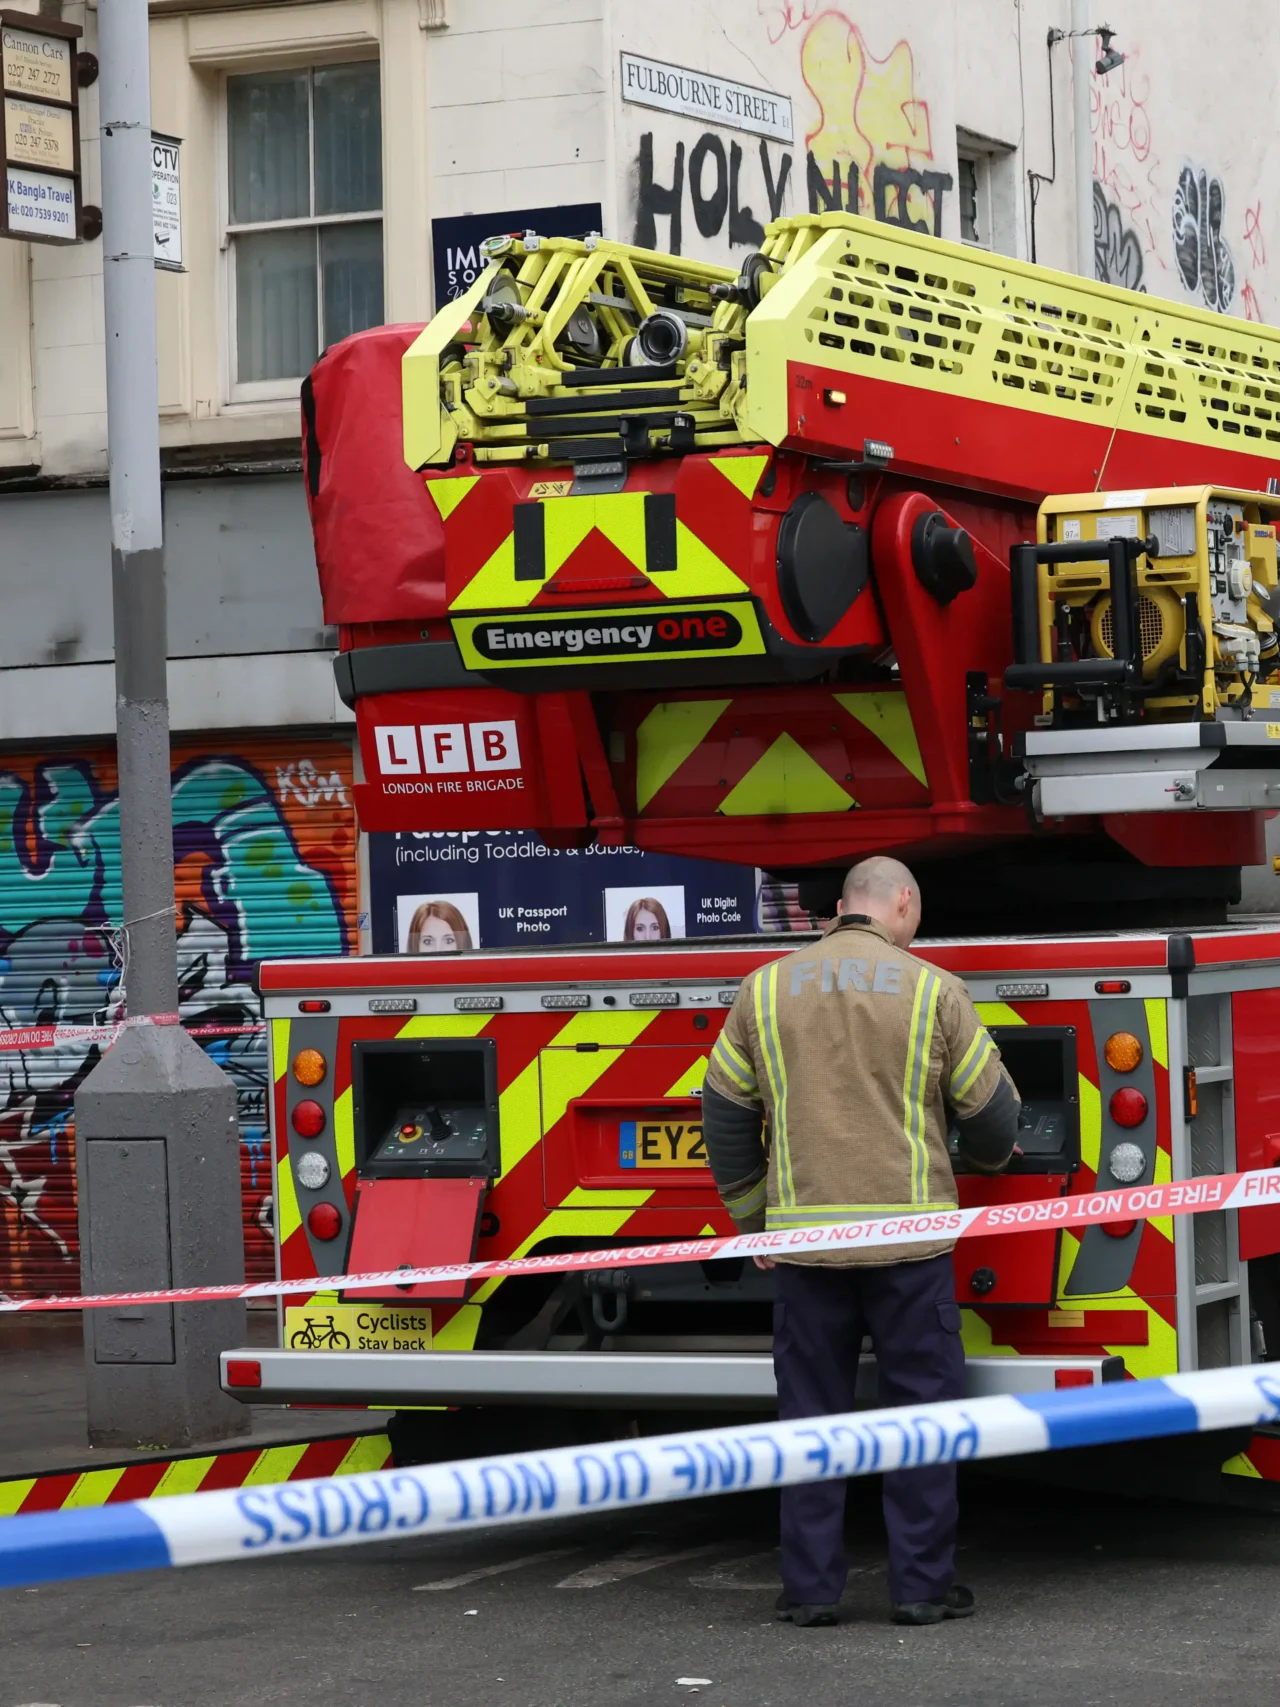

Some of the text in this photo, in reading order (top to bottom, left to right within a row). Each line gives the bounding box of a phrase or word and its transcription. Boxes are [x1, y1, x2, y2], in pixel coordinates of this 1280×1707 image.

[3, 33, 64, 60] Cannon Cars
[7, 63, 60, 86] 0207 247 2727
[626, 63, 722, 111] FULBOURNE
[725, 88, 778, 125] STREET
[15, 133, 27, 146] 020
[30, 136, 41, 148] 247
[152, 146, 178, 171] CTV
[17, 181, 46, 201] Bangla
[47, 186, 73, 204] Travel
[166, 191, 177, 206] 023
[634, 132, 792, 256] HOLY
[8, 202, 69, 223] Tel: 020 7539 9201
[448, 270, 484, 285] SO
[796, 374, 813, 390] 32m
[486, 616, 728, 651] Emergency one
[386, 729, 508, 765] LFB
[382, 777, 525, 794] LONDON FIRE BRIGADE
[395, 845, 480, 866] (including
[499, 905, 567, 920] UK Passport
[701, 897, 737, 909] UK Digital
[516, 922, 551, 932] Photo
[697, 912, 741, 924] Photo Code
[790, 957, 903, 997] FIRE
[622, 1150, 634, 1160] GB
[986, 1181, 1222, 1226] FIRE DO NOT CROSS
[733, 1213, 963, 1250] FIRE DO NOT CROSS
[494, 1239, 716, 1271] FIRE DO NOT CROSS
[264, 1262, 475, 1288] FIRE DO NOT CROSS
[356, 1313, 427, 1333] Cyclists
[358, 1336, 425, 1350] Stay back
[236, 1411, 980, 1548] POLICE LINE DO NOT CROSS
